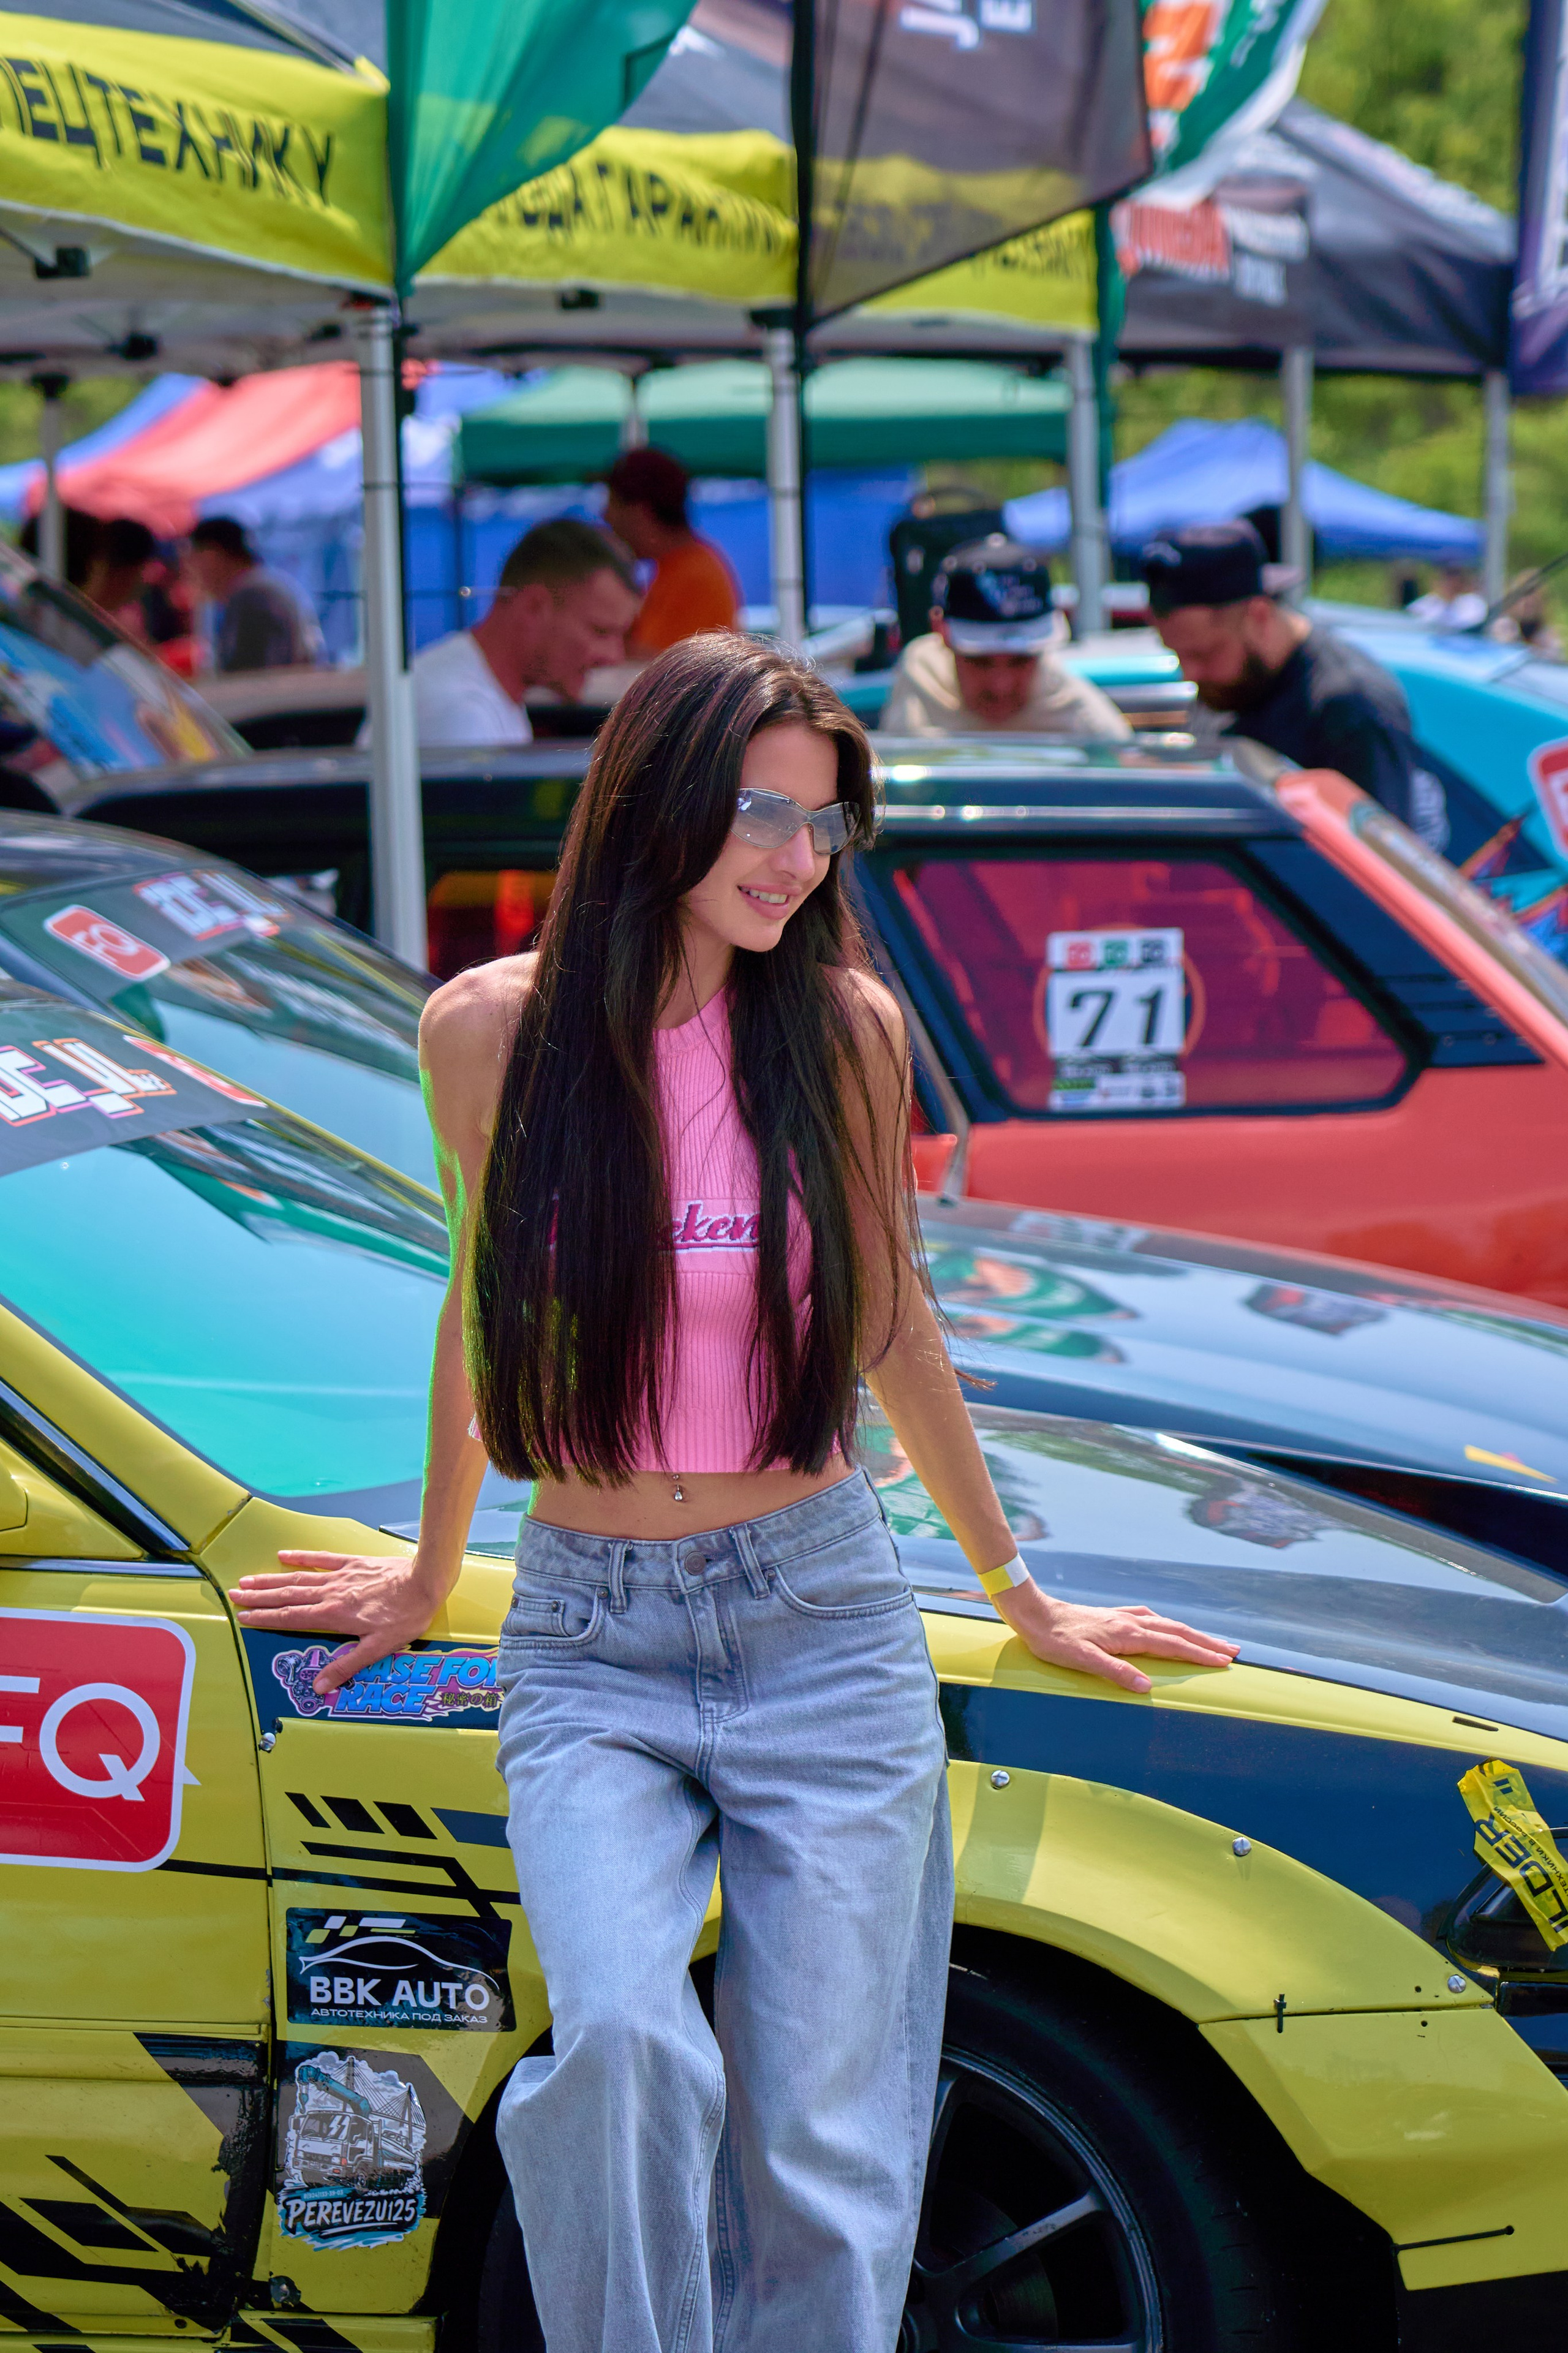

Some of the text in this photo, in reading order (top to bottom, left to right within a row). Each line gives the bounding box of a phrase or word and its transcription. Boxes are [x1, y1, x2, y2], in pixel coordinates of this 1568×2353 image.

[1069, 988, 1165, 1048] 71
[335, 1683, 437, 1714] RACE
[442, 1691, 498, 1707] 秘密の箱
[1536, 1846, 1568, 1897] ТЕХНИКИ
[310, 1976, 490, 2011] BBK AUTO
[311, 2007, 488, 2023] АВТОТЕХНИКА ПОД ЗАКАЗ
[285, 2198, 416, 2229] PEREVEZU125
